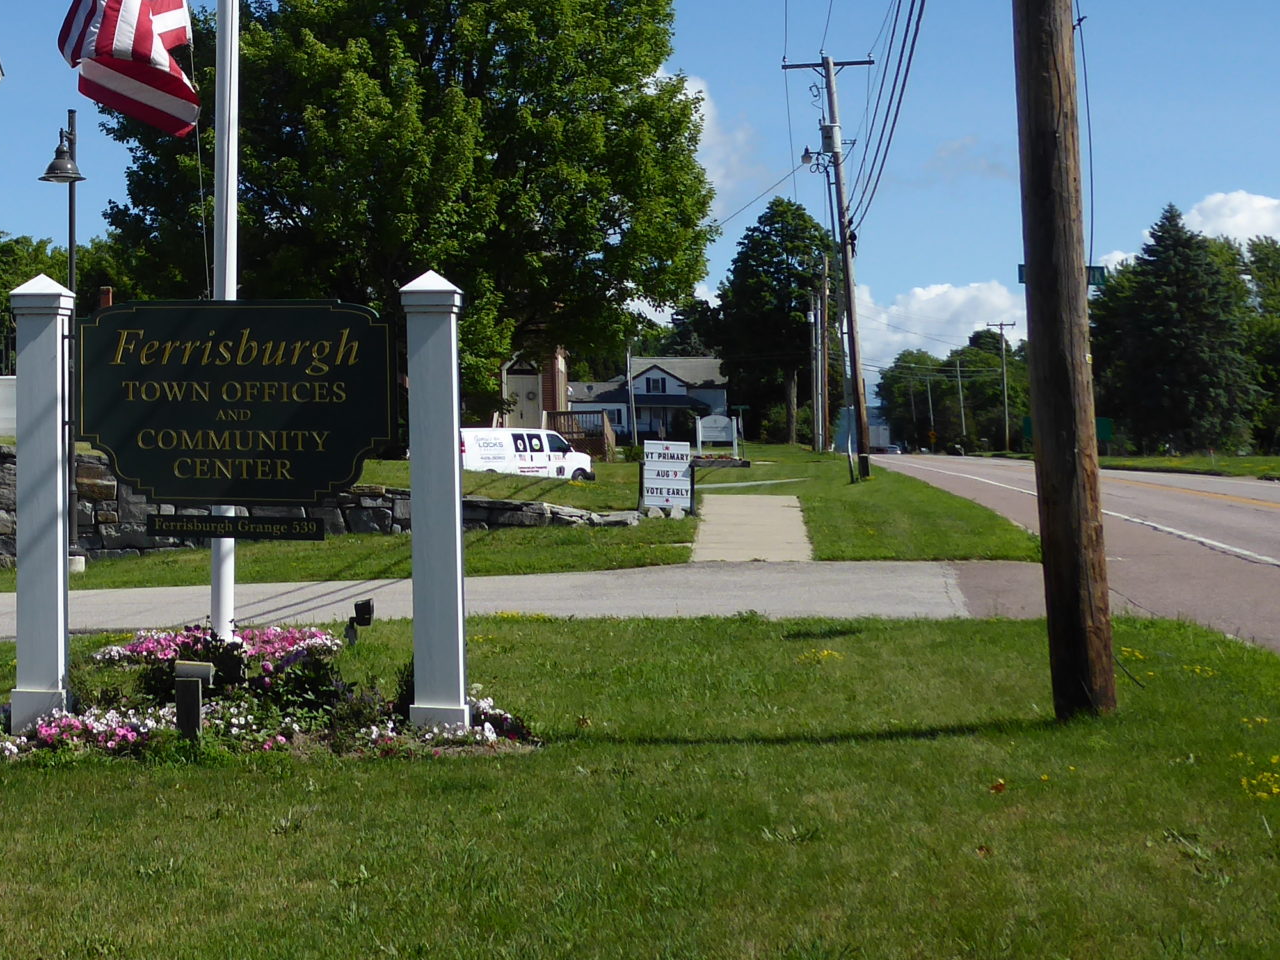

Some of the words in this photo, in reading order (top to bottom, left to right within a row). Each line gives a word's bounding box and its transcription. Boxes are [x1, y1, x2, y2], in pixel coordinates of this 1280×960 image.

[108, 327, 360, 376] Ferrisburgh
[122, 381, 210, 402] TOWN
[222, 381, 347, 403] OFFICES
[216, 409, 251, 422] AND
[137, 429, 331, 452] COMMUNITY
[645, 452, 654, 460] VT
[658, 452, 690, 461] PRIMARY
[173, 458, 295, 480] CENTER
[656, 470, 670, 478] AUG
[673, 470, 678, 478] 9
[645, 487, 663, 495] VOTE
[667, 488, 690, 497] EARLY
[154, 517, 233, 534] Ferrisburgh
[238, 520, 288, 536] Grange
[292, 521, 317, 534] 539
